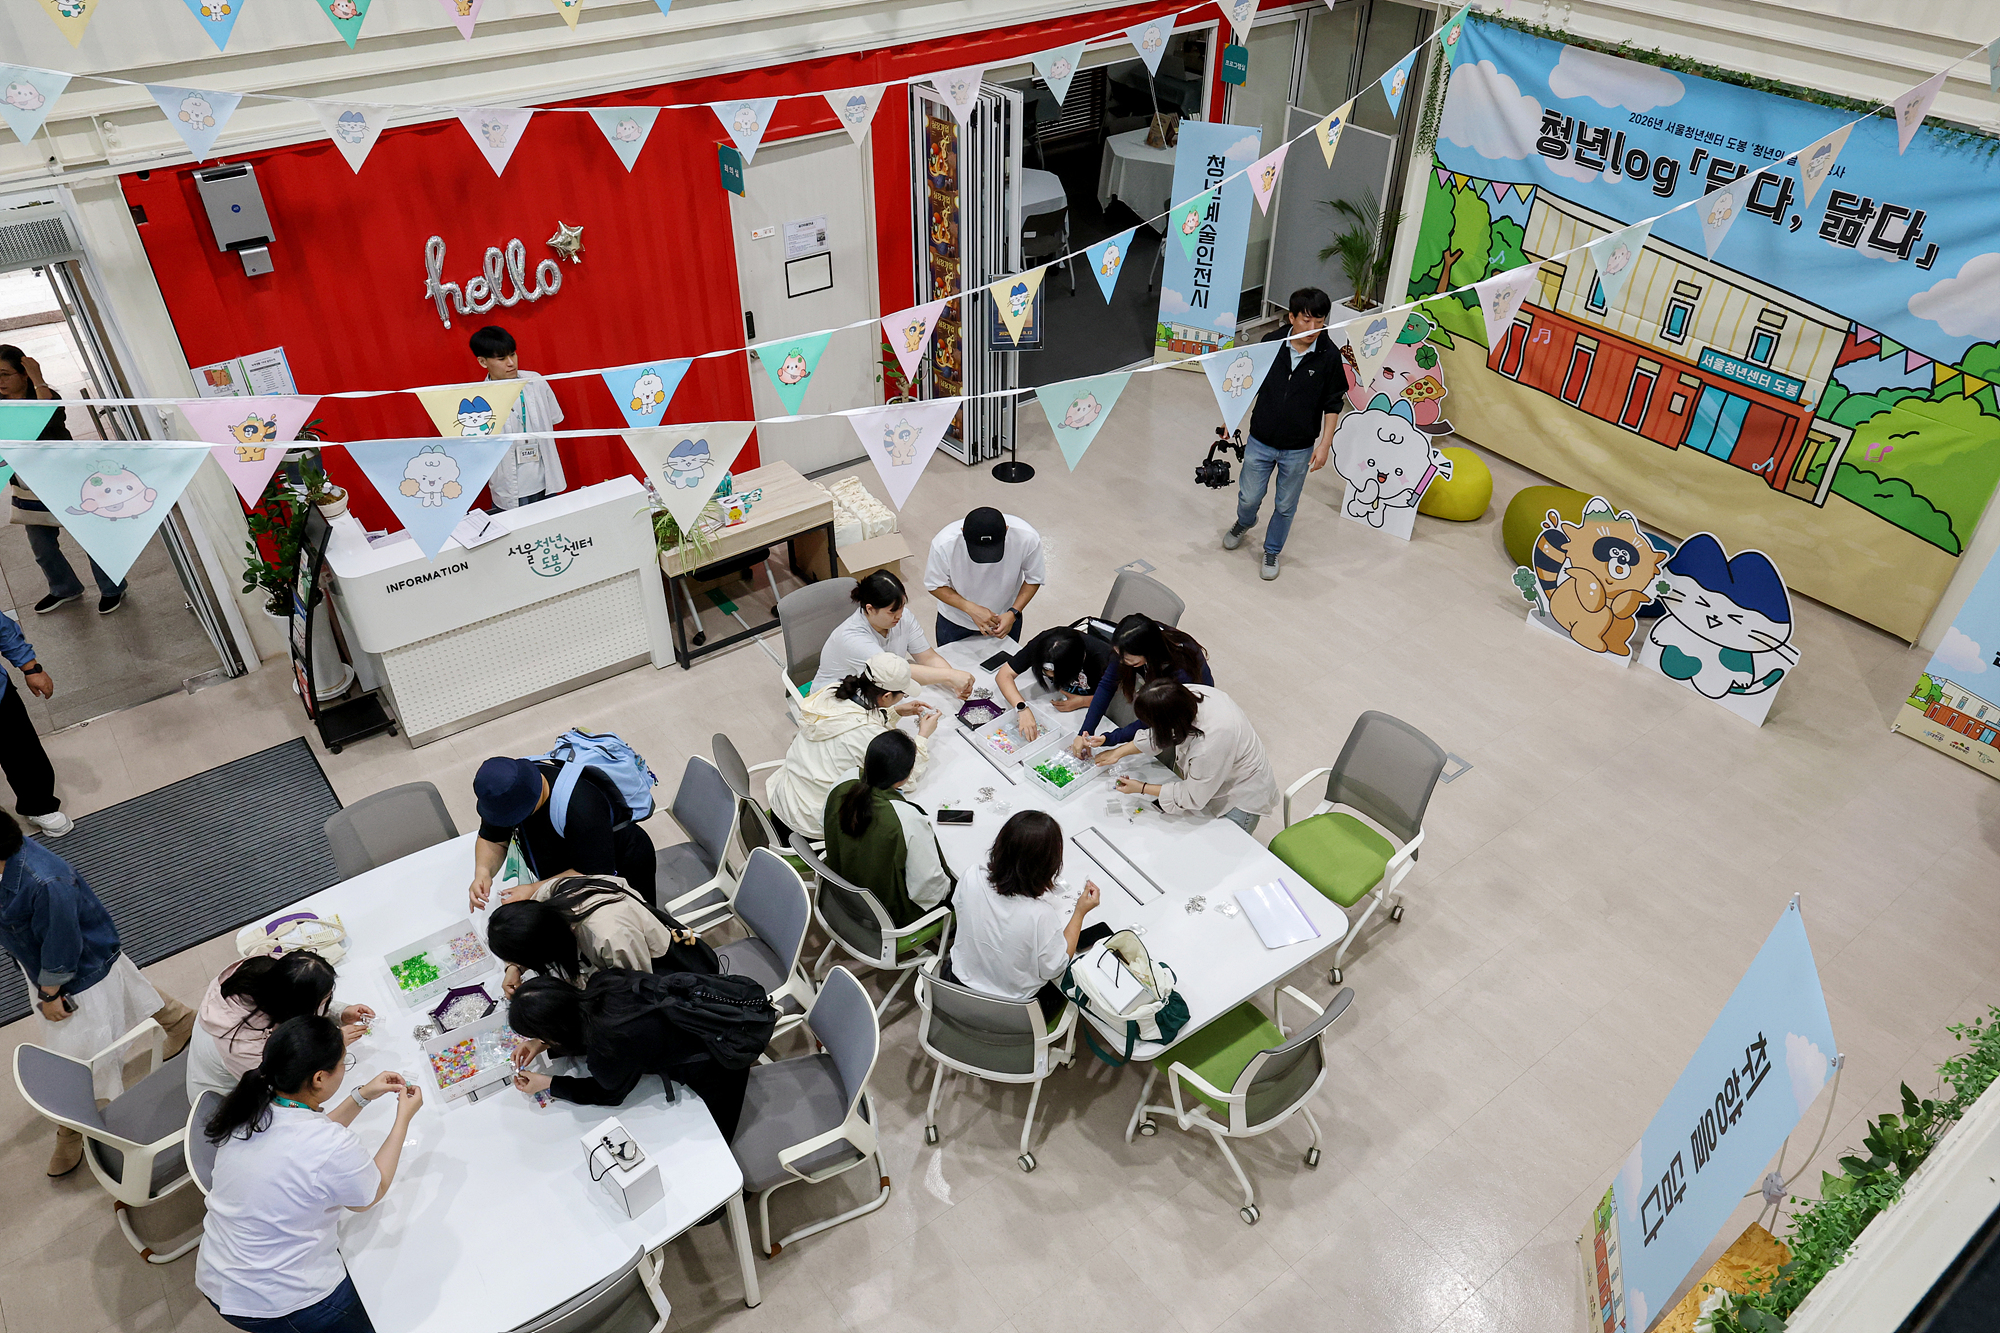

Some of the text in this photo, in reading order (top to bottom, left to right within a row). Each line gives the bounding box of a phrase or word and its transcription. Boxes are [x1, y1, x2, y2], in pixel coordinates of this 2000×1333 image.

[1535, 108, 1681, 198] 청년log
[1629, 112, 1663, 131] 2026년
[1665, 121, 1725, 147] 서울청년센터
[1726, 137, 1748, 153] 도봉
[425, 235, 563, 329] hello
[1701, 354, 1799, 397] 서울청년센터 도봉
[386, 561, 469, 594] INFORMATION
[1641, 1031, 1772, 1248] 취향을 담다
